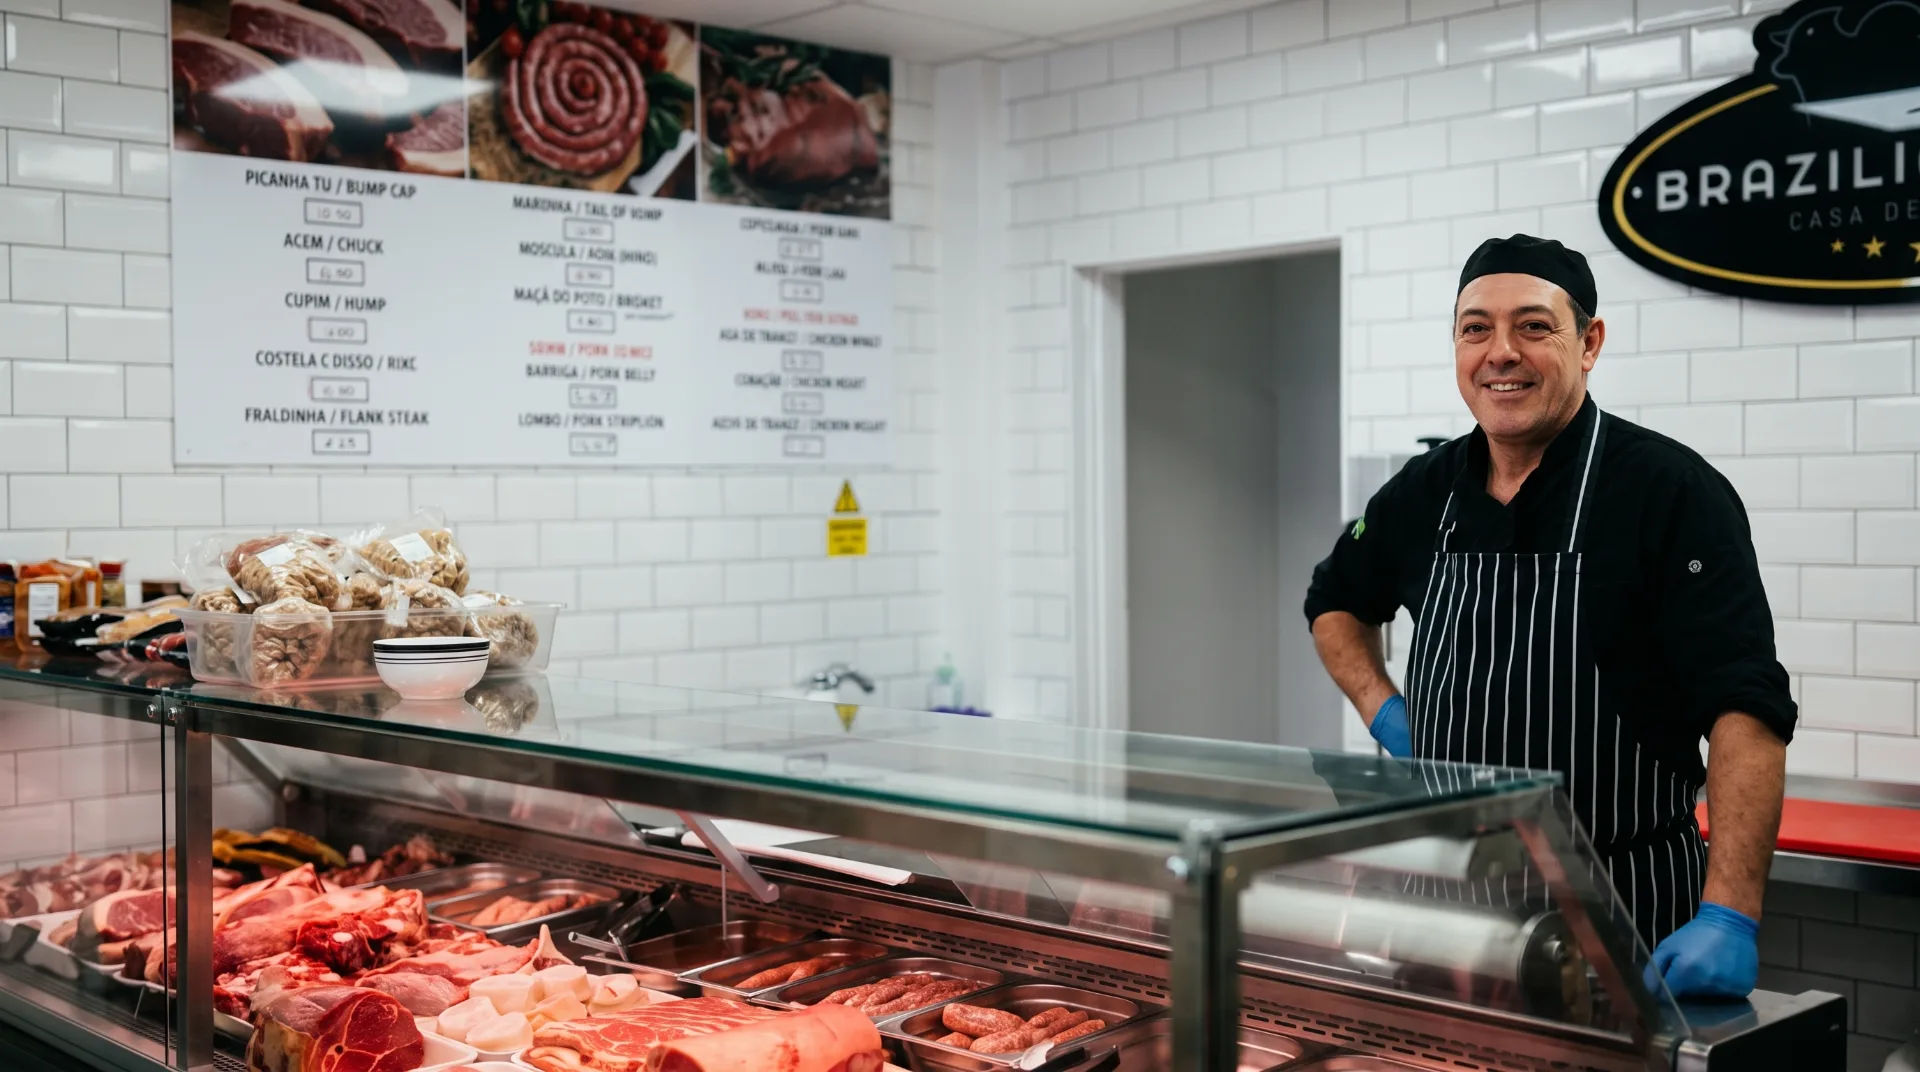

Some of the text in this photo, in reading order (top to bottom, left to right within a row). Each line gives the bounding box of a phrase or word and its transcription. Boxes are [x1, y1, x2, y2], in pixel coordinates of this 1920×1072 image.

[245, 170, 308, 190] PICANHA
[390, 183, 417, 199] CAP
[1656, 141, 1920, 212] BRAZILI
[1789, 199, 1920, 231] CASA DE
[284, 233, 323, 250] ACEM
[337, 236, 384, 254] CHUCK
[285, 292, 330, 310] CUPIM
[345, 297, 386, 311] HUMP
[255, 350, 317, 368] COSTELA
[245, 407, 326, 424] FRALDINHA
[340, 409, 384, 425] FLANK
[388, 410, 429, 425] STEAK
